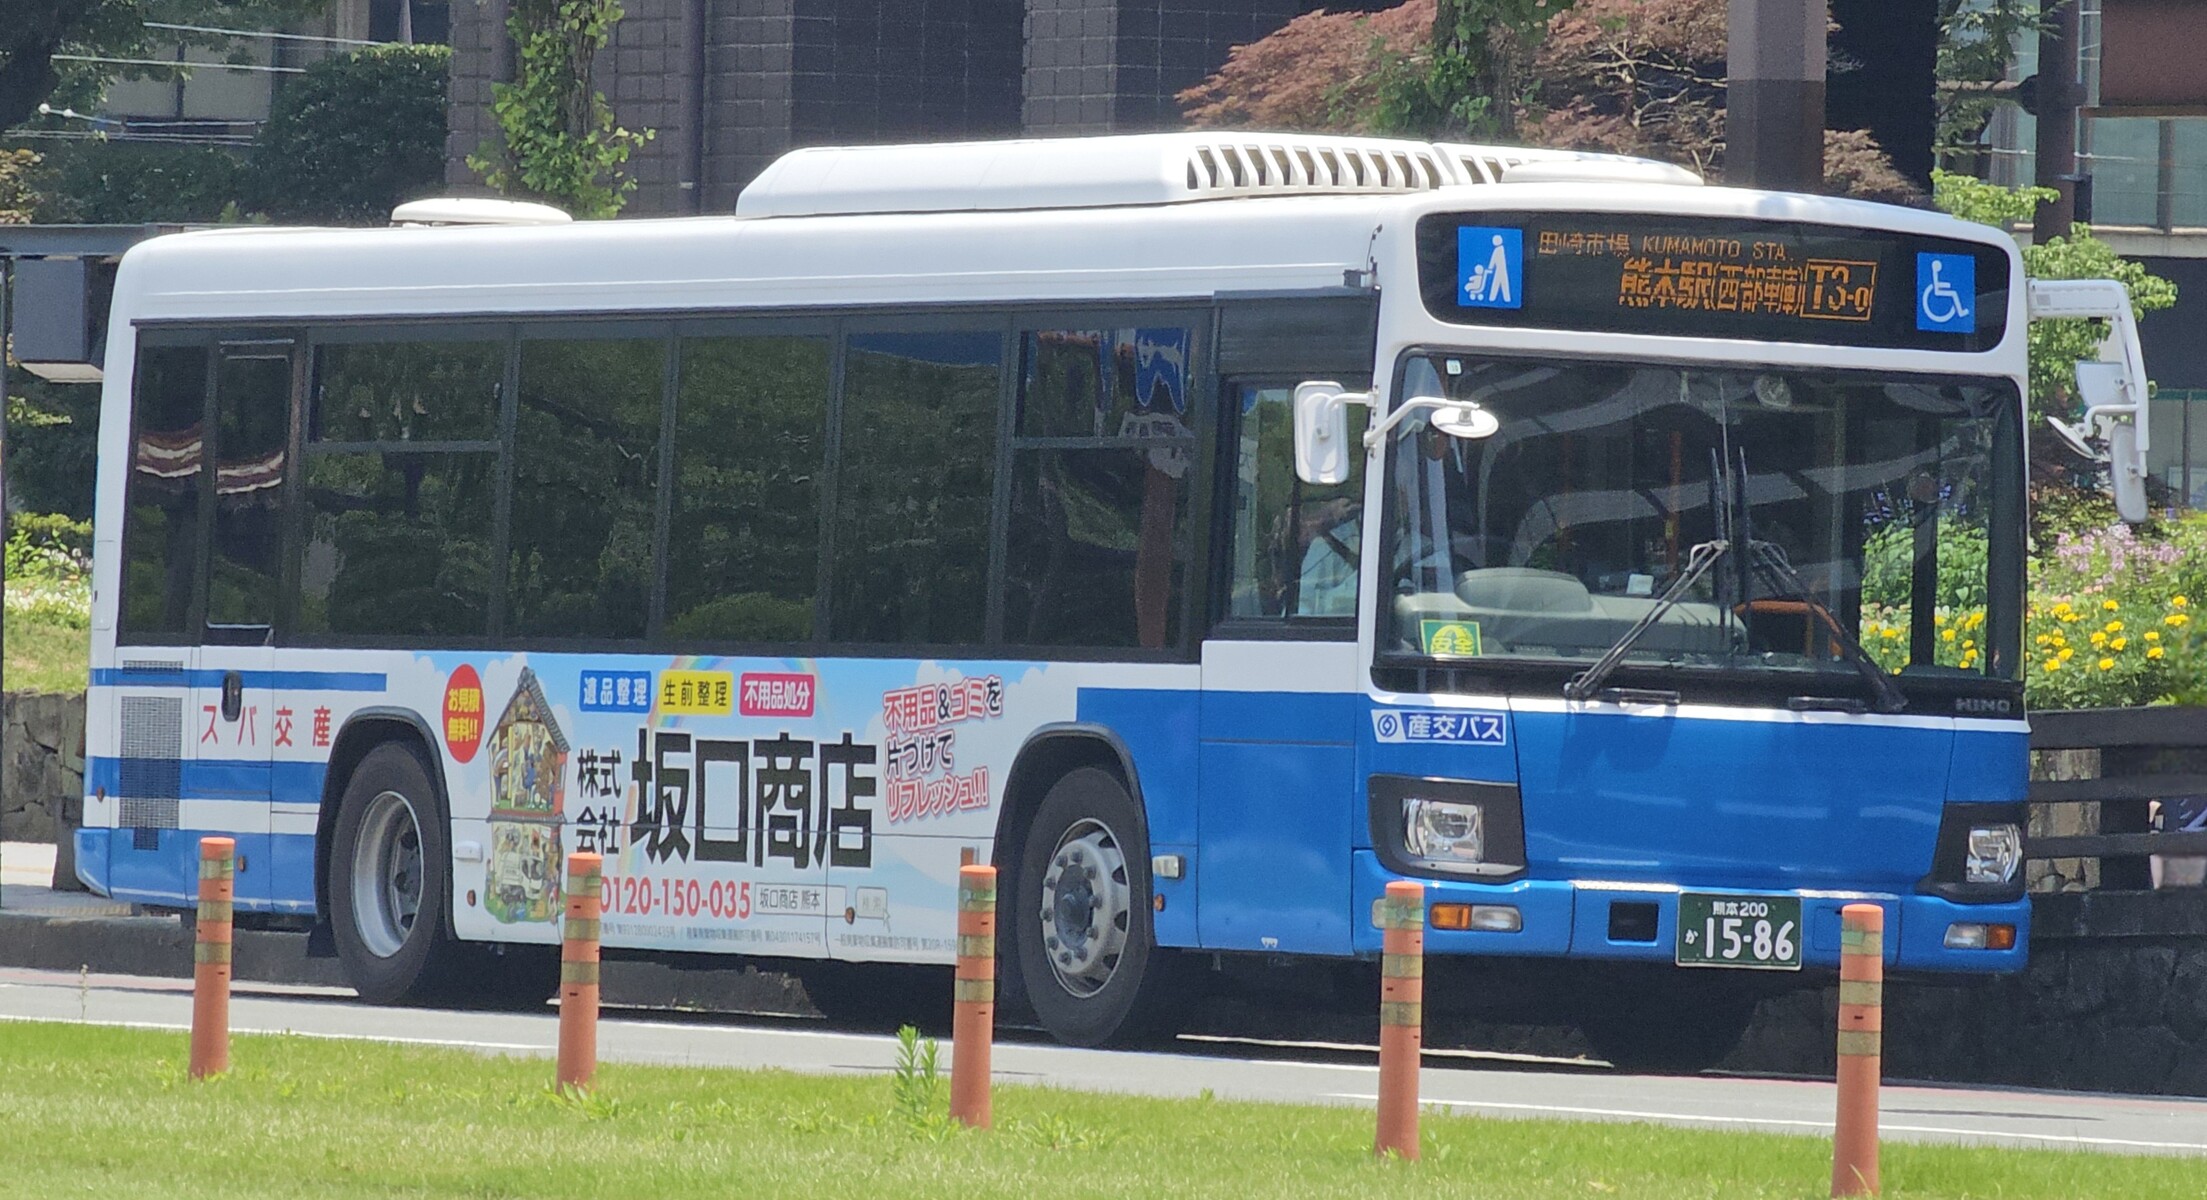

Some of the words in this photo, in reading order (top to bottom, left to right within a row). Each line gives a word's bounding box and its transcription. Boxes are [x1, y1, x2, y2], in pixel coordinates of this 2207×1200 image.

[1642, 235, 1741, 258] KUMAMOTO
[1753, 241, 1795, 262] STA.
[448, 688, 480, 712] お見積
[583, 676, 648, 706] 遺品整理
[663, 679, 728, 707] 生前整理
[745, 680, 811, 711] 不用品処分
[884, 675, 1002, 732] 不用品&ゴミを
[1955, 698, 2010, 712] HINO
[1408, 714, 1502, 740] 産交バス
[885, 729, 954, 779] 片づけて
[576, 748, 622, 799] 株式
[630, 728, 877, 869] 坂口商店
[576, 806, 620, 856] 会社
[600, 876, 751, 919] 0120-150-035
[759, 888, 798, 910] 坂口商店
[801, 891, 821, 912] 熊本
[1685, 929, 1699, 945] か
[1705, 917, 1795, 961] 15-86
